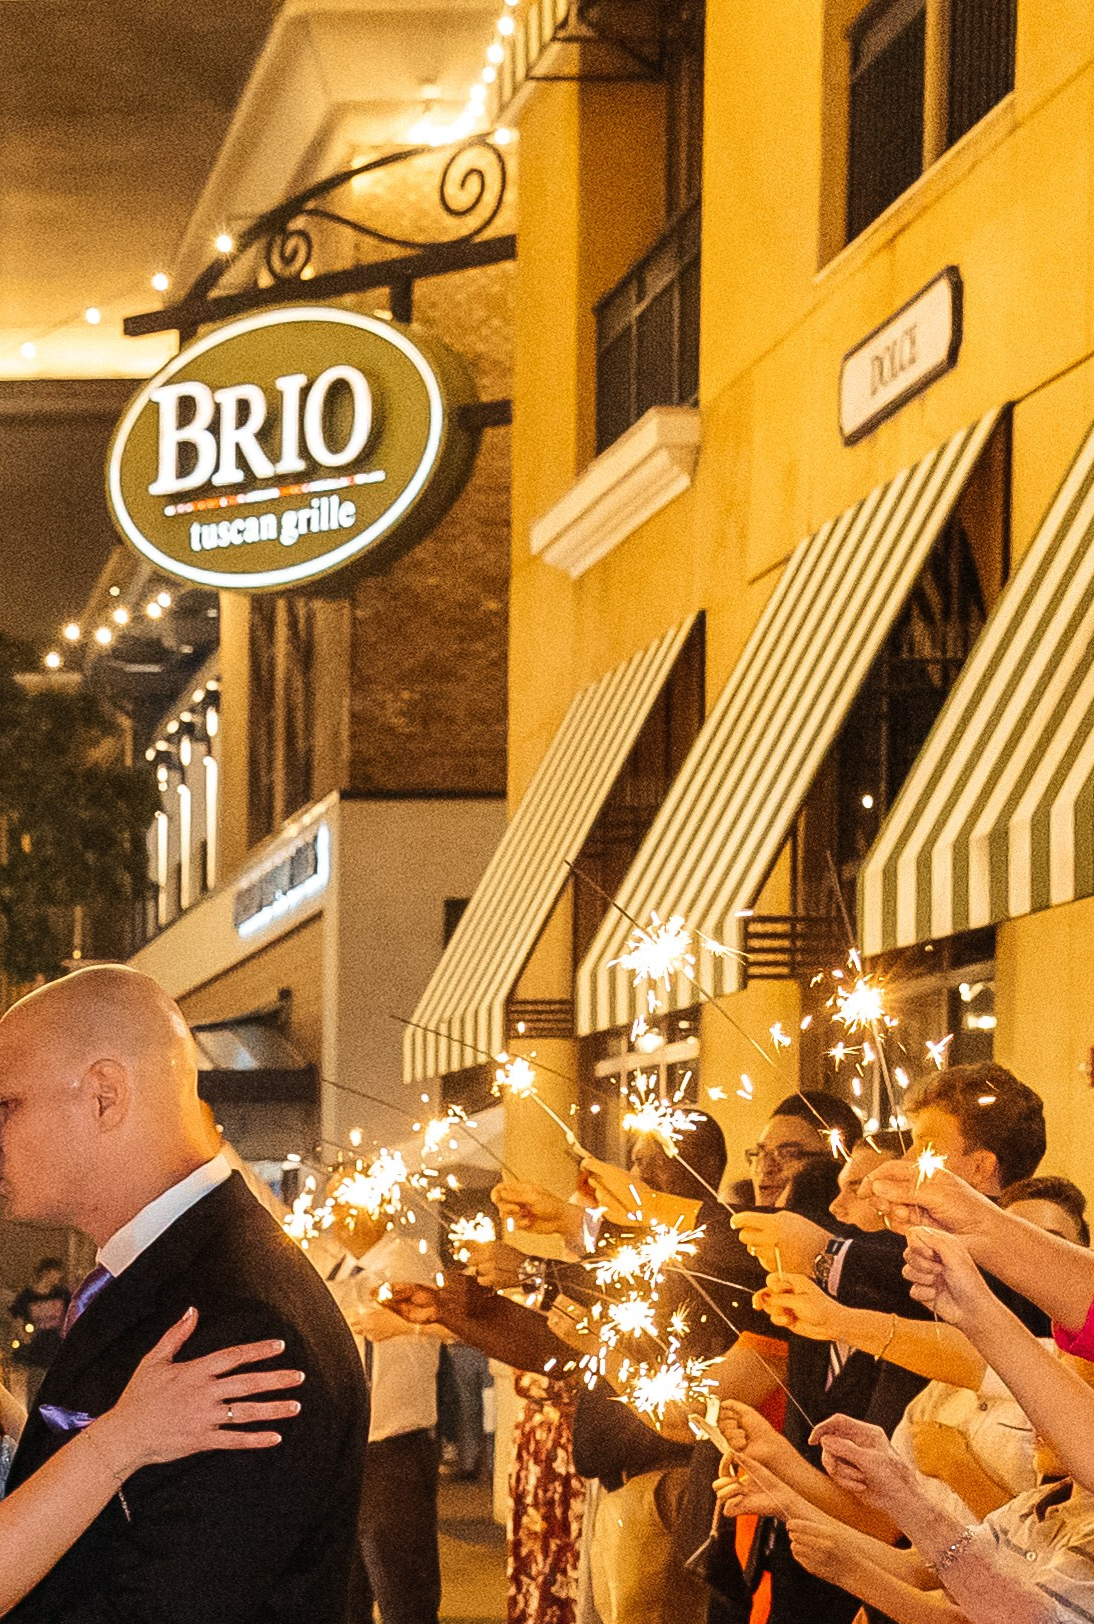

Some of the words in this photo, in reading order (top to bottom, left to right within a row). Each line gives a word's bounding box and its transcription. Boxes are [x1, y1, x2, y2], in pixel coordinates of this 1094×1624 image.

[148, 364, 373, 495] BRIO
[189, 513, 278, 552] tuscan
[280, 494, 357, 546] grille
